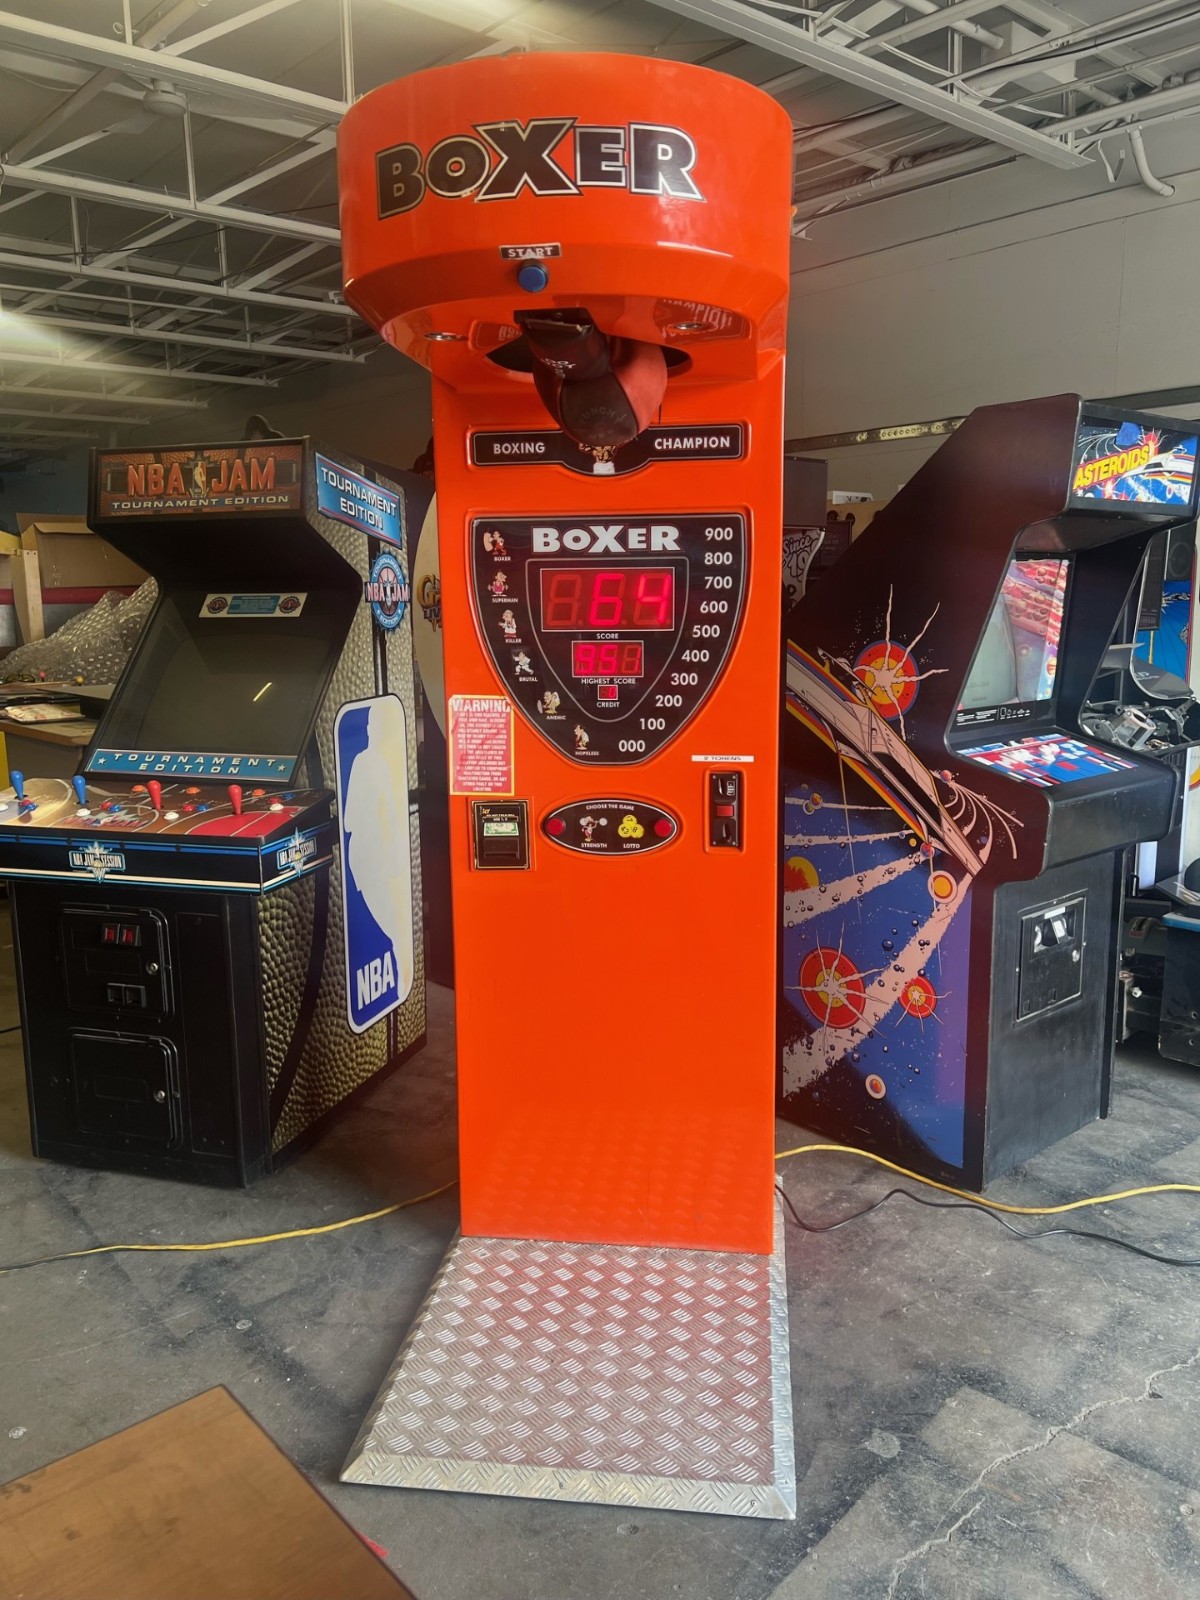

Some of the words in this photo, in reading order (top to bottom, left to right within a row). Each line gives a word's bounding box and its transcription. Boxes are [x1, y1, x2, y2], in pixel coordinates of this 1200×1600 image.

[375, 117, 706, 220] BOXER
[508, 247, 553, 258] START
[493, 442, 545, 455] BOXING
[654, 436, 731, 450] CHAMPION
[1073, 445, 1151, 491] ASTEROIDS
[127, 462, 186, 497] NBA
[211, 456, 276, 493] JAM
[321, 466, 397, 516] TOURNAMENT
[112, 499, 219, 510] TOURNAMENT
[225, 495, 289, 506] EDITION
[340, 496, 384, 530] EDITION
[532, 525, 681, 552] BOXER
[705, 527, 733, 541] 900
[704, 551, 733, 565] 800
[704, 576, 733, 589] 700
[367, 582, 386, 602] NBA
[392, 582, 409, 602] JAM
[589, 573, 672, 626] 64
[700, 600, 728, 614] 600
[692, 624, 720, 638] 500
[681, 649, 710, 662] 400
[613, 677, 637, 685] SCORE
[670, 672, 698, 686] 300
[452, 699, 511, 712] WARNING
[655, 694, 683, 707] 200
[640, 717, 666, 730] 100
[618, 739, 646, 752] 000
[114, 753, 276, 766] TOURNAMENT
[139, 763, 240, 774] EDITION
[356, 945, 395, 1011] NBA
